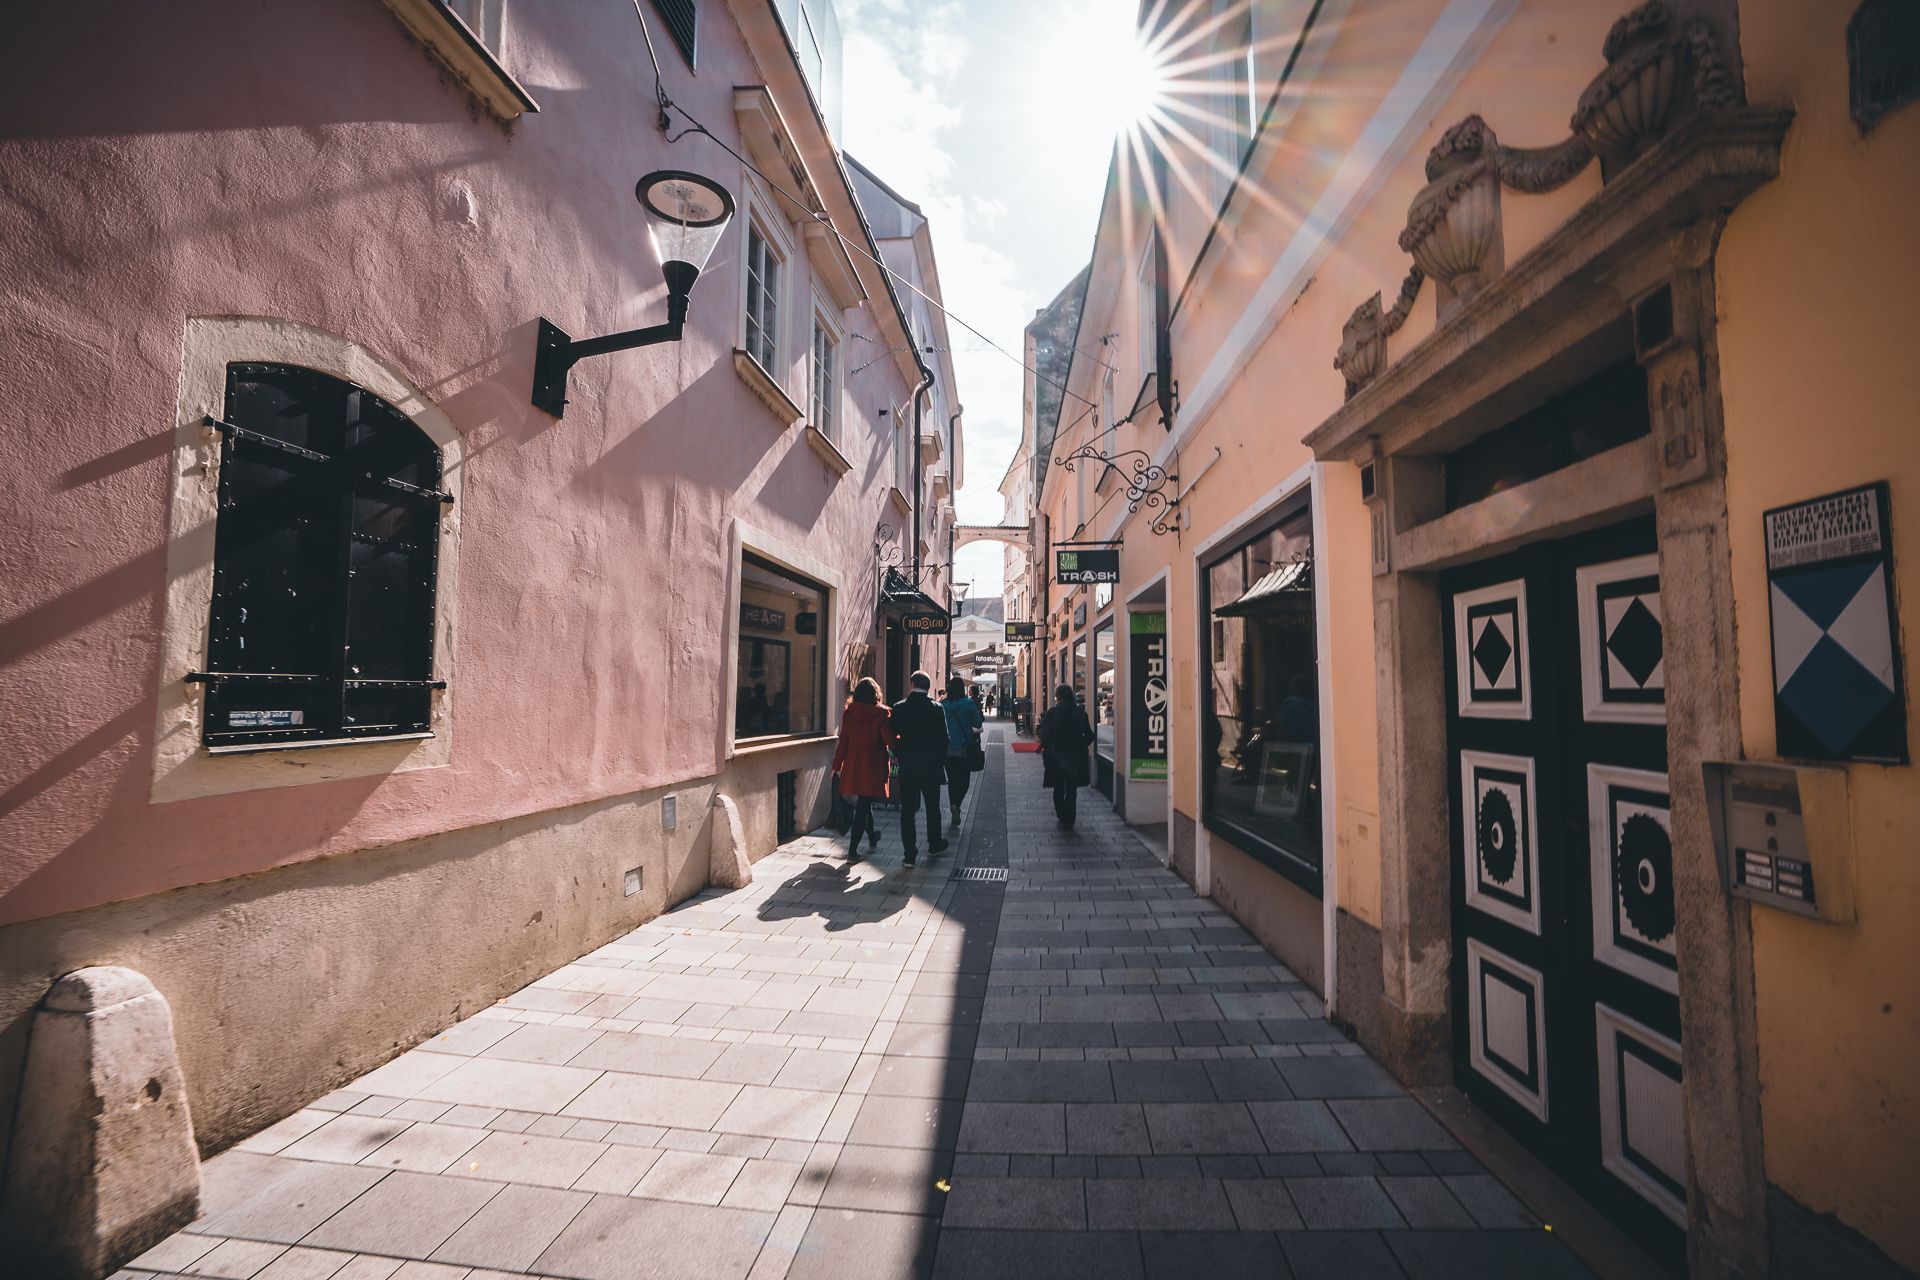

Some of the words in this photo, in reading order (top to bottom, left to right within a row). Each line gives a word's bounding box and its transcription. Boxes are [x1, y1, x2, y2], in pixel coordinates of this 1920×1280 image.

[1772, 491, 1868, 523] KULTURDENKMAL
[1772, 512, 1814, 531] CULTURAL
[1817, 499, 1870, 521] PROPERTY
[1805, 509, 1870, 533] CULTUREL
[1060, 561, 1077, 569] Store
[1061, 570, 1116, 582] TRASH
[1145, 638, 1167, 754] TRASH
